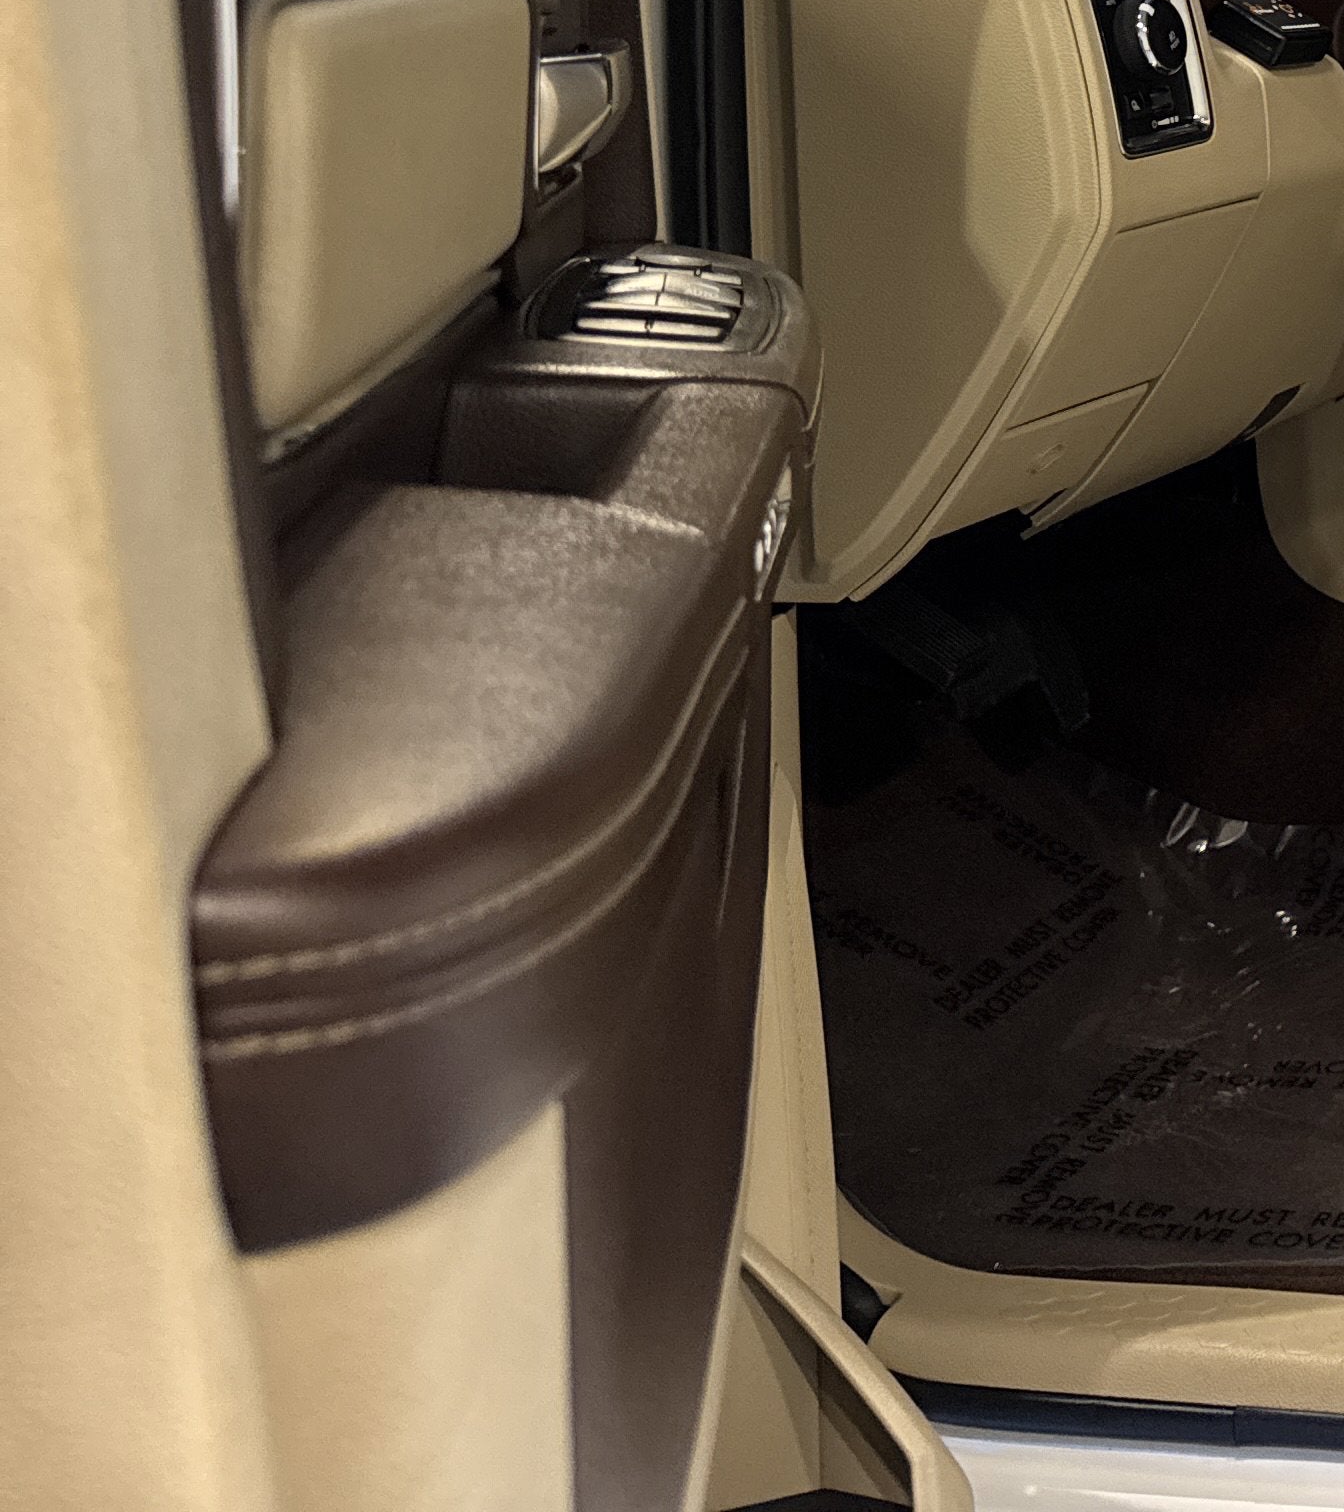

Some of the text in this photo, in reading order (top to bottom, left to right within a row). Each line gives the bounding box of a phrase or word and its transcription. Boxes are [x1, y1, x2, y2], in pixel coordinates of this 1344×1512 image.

[931, 869, 1124, 1015] DEALER MUST REMOVE
[962, 906, 1123, 1032] PROTECTIVE COVER
[996, 1132, 1071, 1186] COVER
[1031, 1212, 1237, 1245] PROTECTIVE
[1051, 1193, 1176, 1220] DEALER
[1192, 1206, 1297, 1226] MUST
